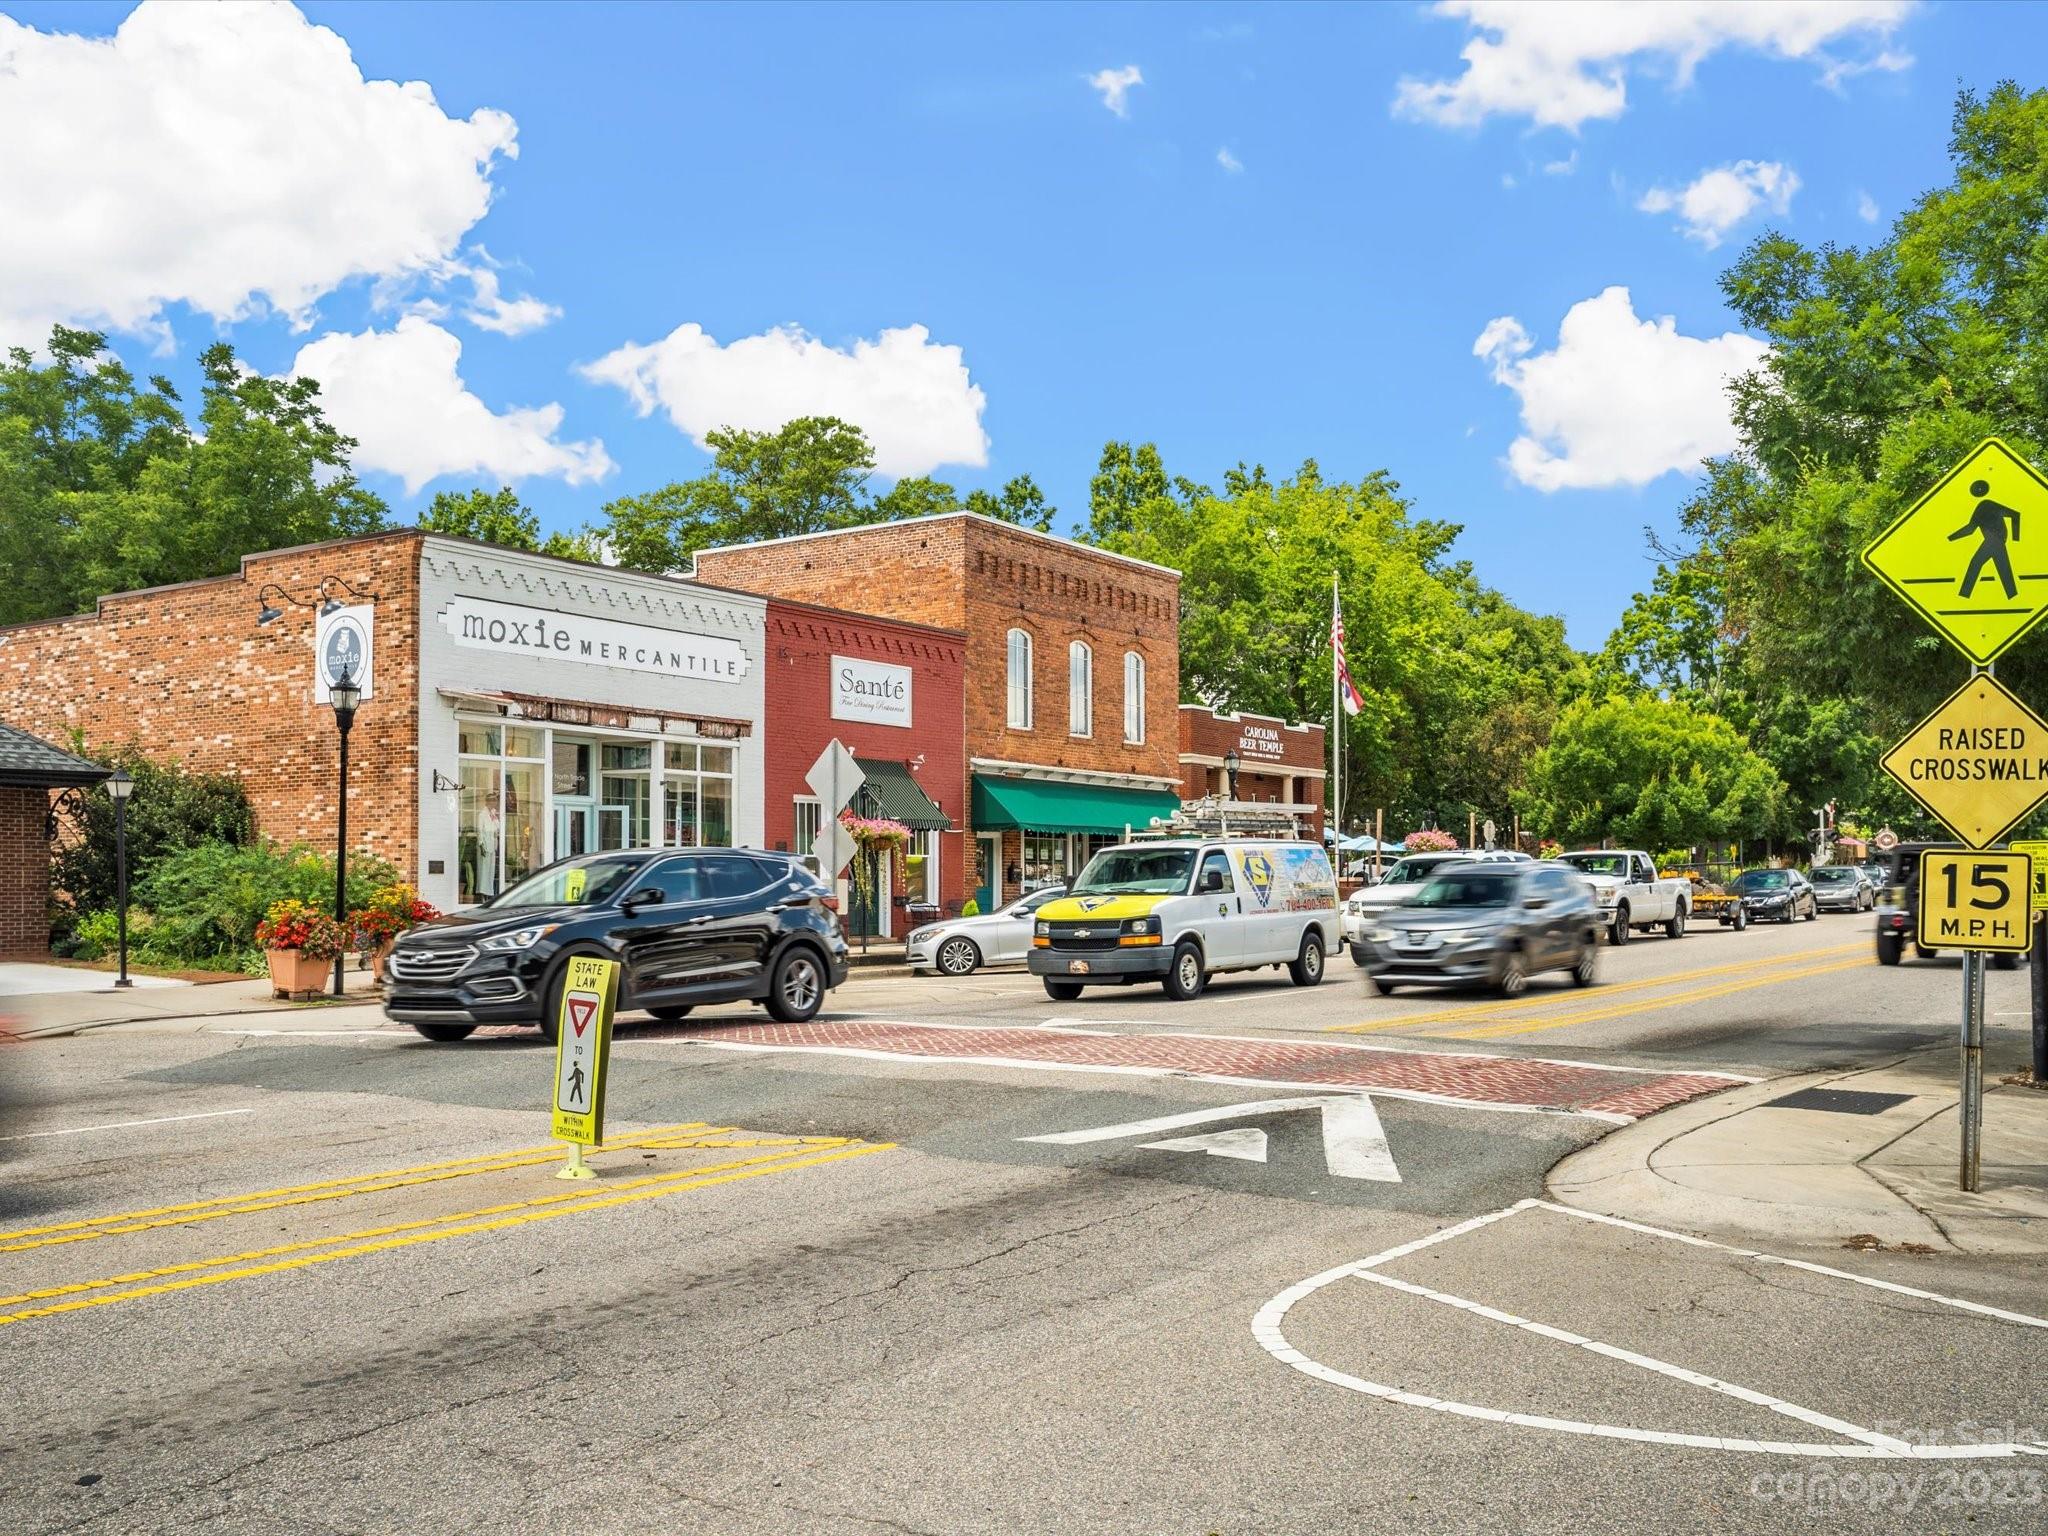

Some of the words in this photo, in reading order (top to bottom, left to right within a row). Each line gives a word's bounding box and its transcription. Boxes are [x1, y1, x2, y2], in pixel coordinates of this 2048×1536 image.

[462, 613, 571, 651] moxie
[580, 639, 735, 676] MERCANTILE
[328, 651, 360, 666] moxie
[840, 668, 904, 700] Santé
[1244, 726, 1279, 741] CAROLINA
[1939, 728, 2025, 750] RAISED
[1239, 737, 1257, 750] BEER
[1258, 740, 1285, 754] TEMPLE
[1909, 758, 2048, 780] CROSSWALK
[1941, 863, 2011, 911] 15
[1940, 918, 2015, 939] M.P.H.
[575, 962, 604, 976] STATE
[575, 976, 597, 988] LAW
[574, 1045, 583, 1055] TO
[563, 1115, 584, 1127] WITHIN
[556, 1126, 590, 1140] CROSSWALK
